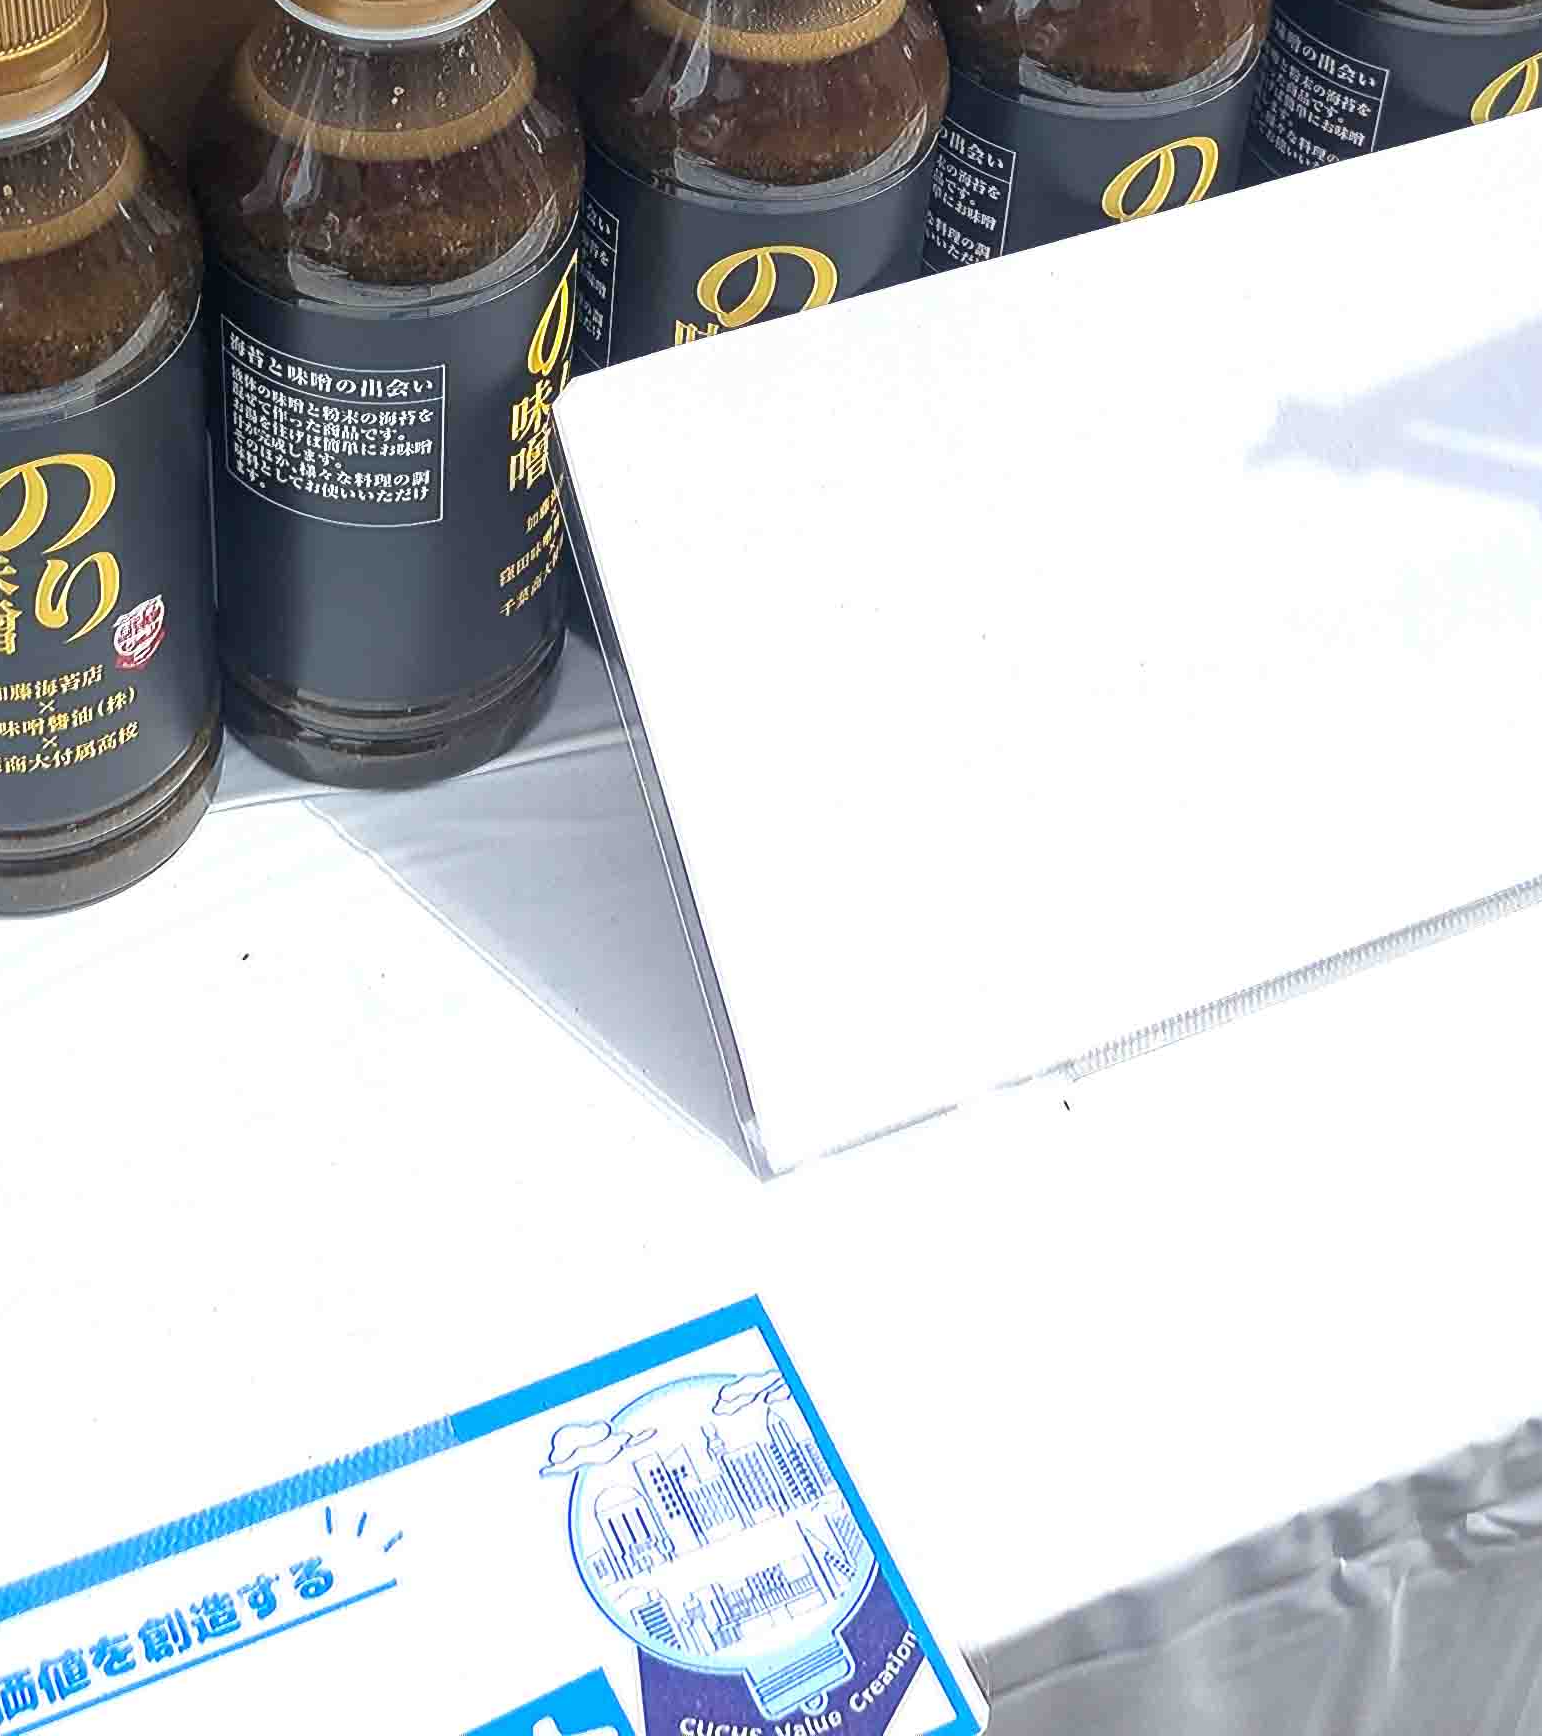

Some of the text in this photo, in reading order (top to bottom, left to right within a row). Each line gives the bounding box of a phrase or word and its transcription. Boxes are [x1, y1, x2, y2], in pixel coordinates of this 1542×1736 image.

[1100, 135, 1219, 222] の
[697, 244, 838, 328] の
[230, 331, 434, 398] 海苔と味噌の出会い
[849, 1629, 917, 1714] Creation
